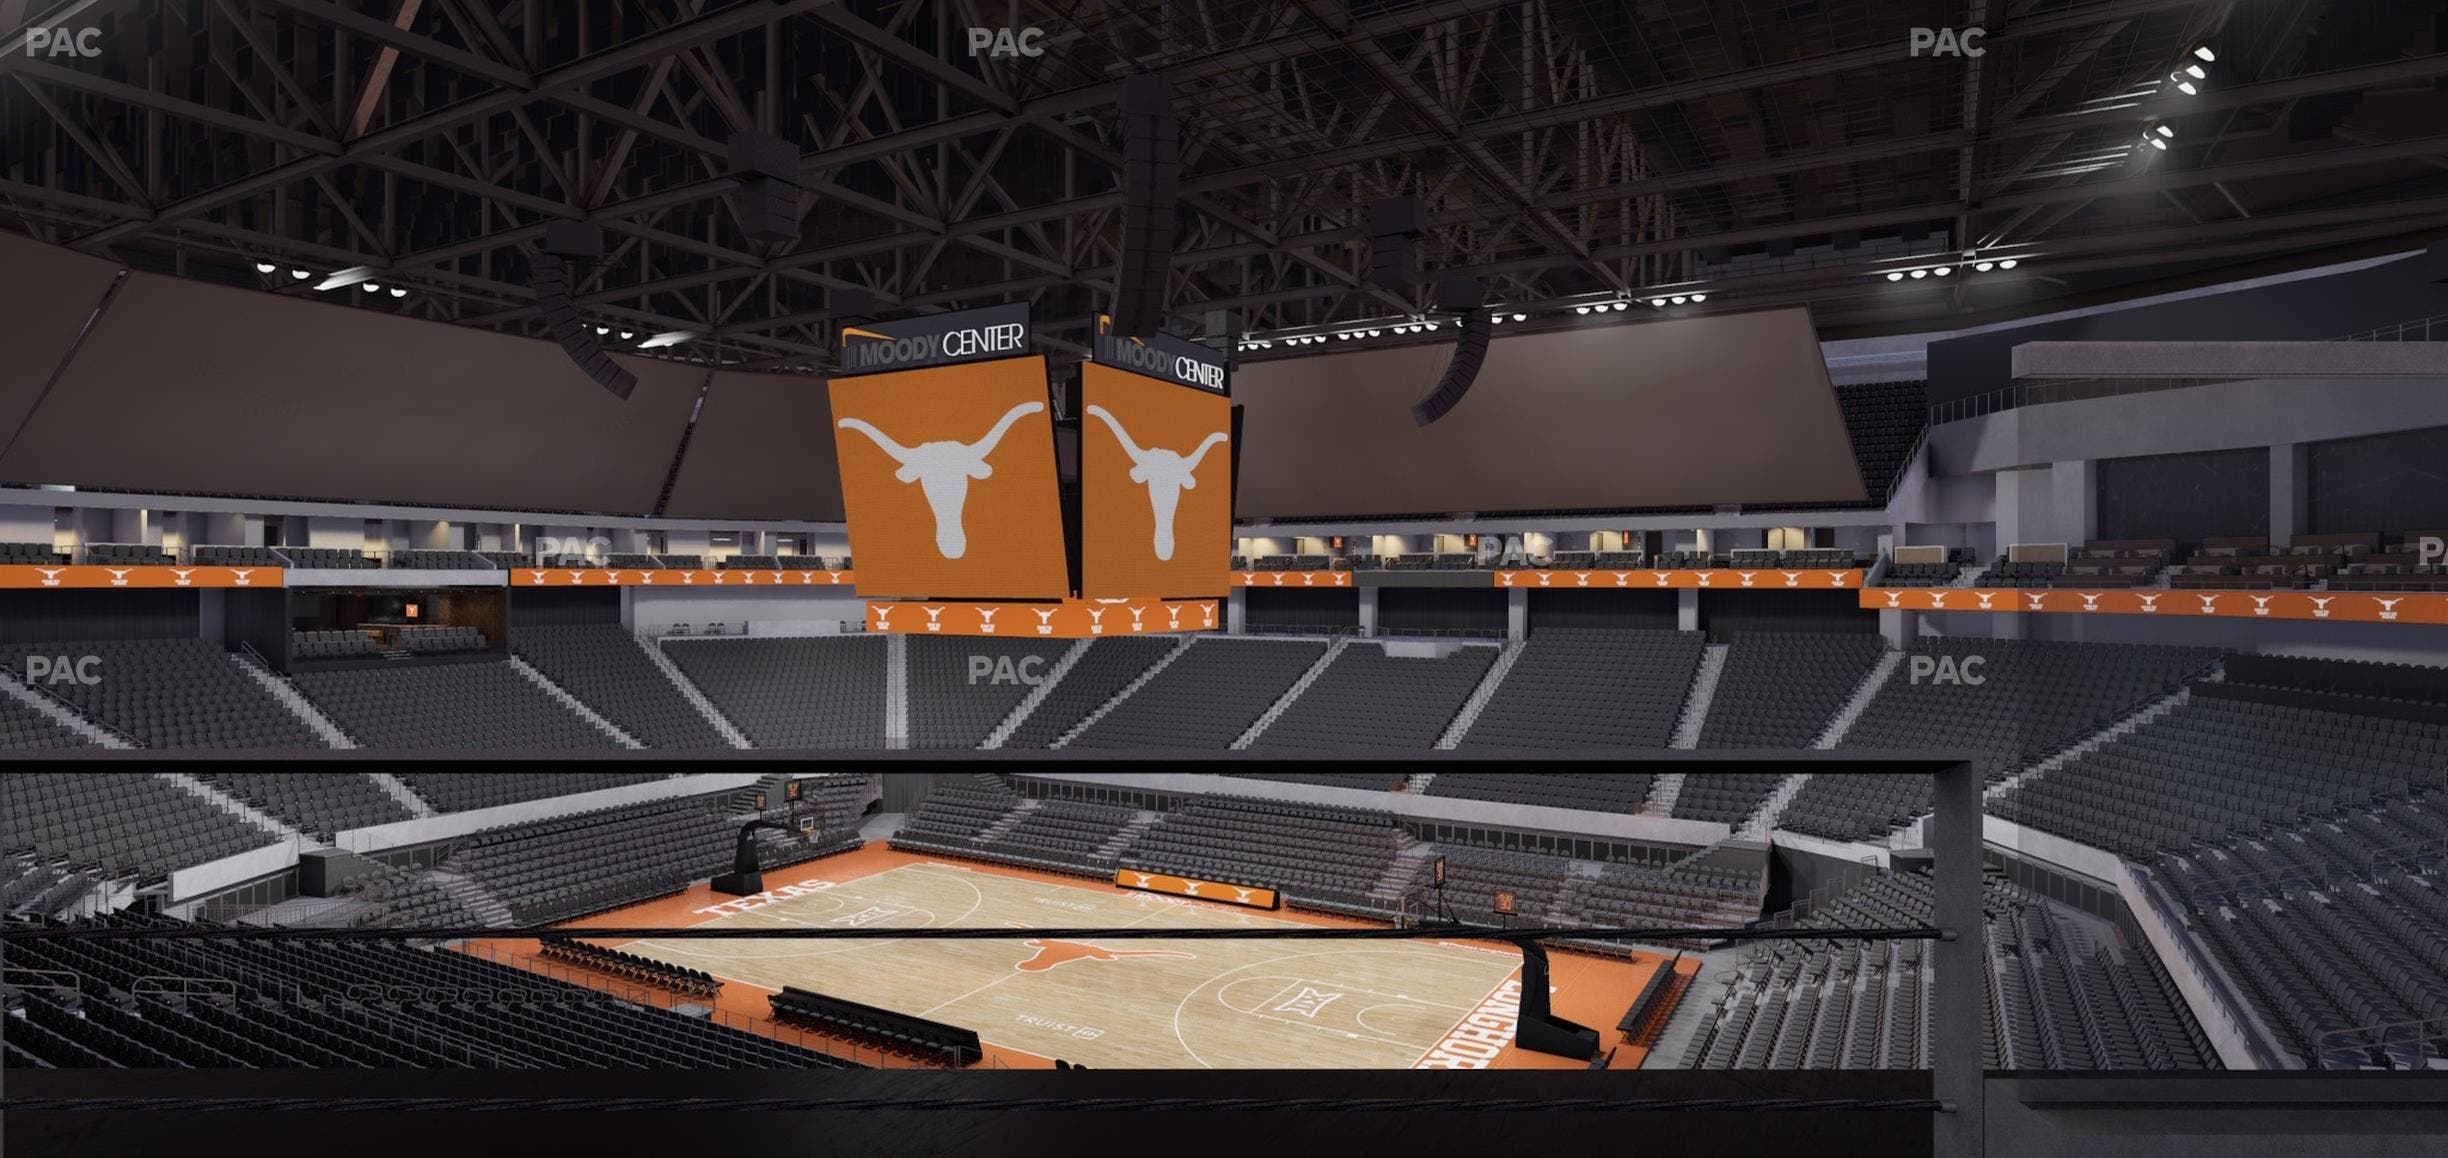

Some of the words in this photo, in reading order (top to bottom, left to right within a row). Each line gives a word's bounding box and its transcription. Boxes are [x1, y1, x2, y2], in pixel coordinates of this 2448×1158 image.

[860, 333, 941, 367] MOODY
[943, 323, 1024, 357] CENTER
[1116, 338, 1176, 375] MOODY
[1175, 356, 1224, 389] CENTER
[692, 879, 837, 918] TEXAS
[1016, 1014, 1078, 1033] TRUIST
